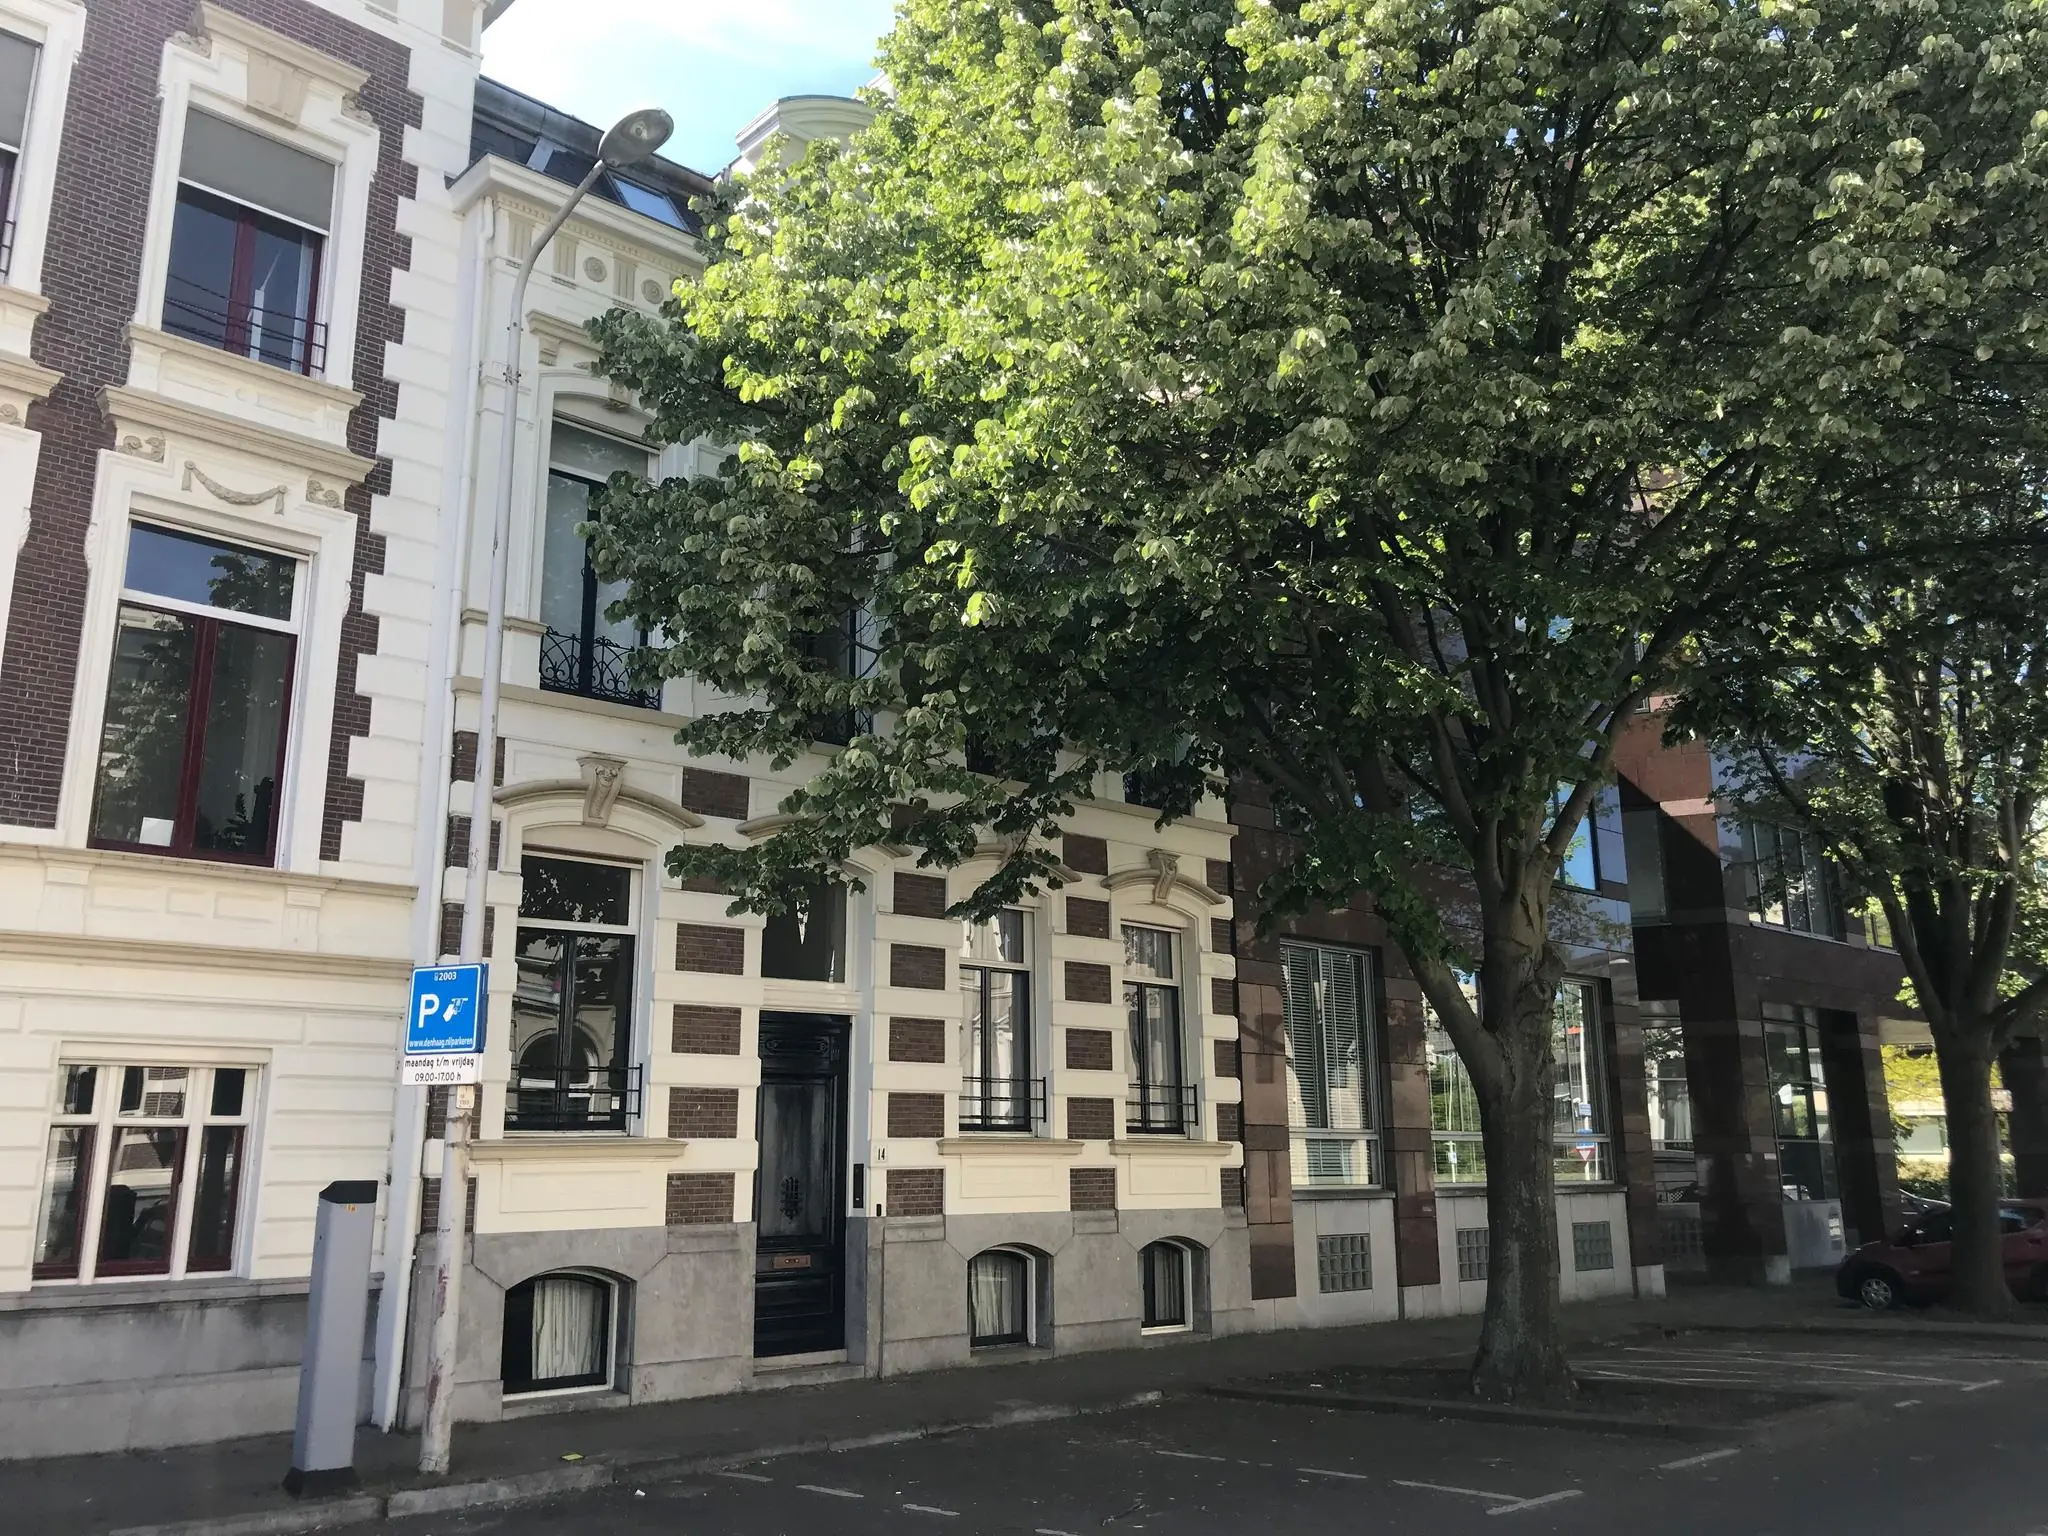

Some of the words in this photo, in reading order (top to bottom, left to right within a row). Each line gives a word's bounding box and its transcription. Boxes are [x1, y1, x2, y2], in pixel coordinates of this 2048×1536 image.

[438, 972, 457, 981] 2003
[418, 993, 440, 1028] P
[405, 1058, 434, 1068] maandag
[436, 1057, 450, 1067] t/m
[451, 1057, 474, 1068] vrijdag
[414, 1072, 455, 1082] 09.00-17.00
[456, 1072, 462, 1081] h
[878, 1147, 885, 1160] 14
